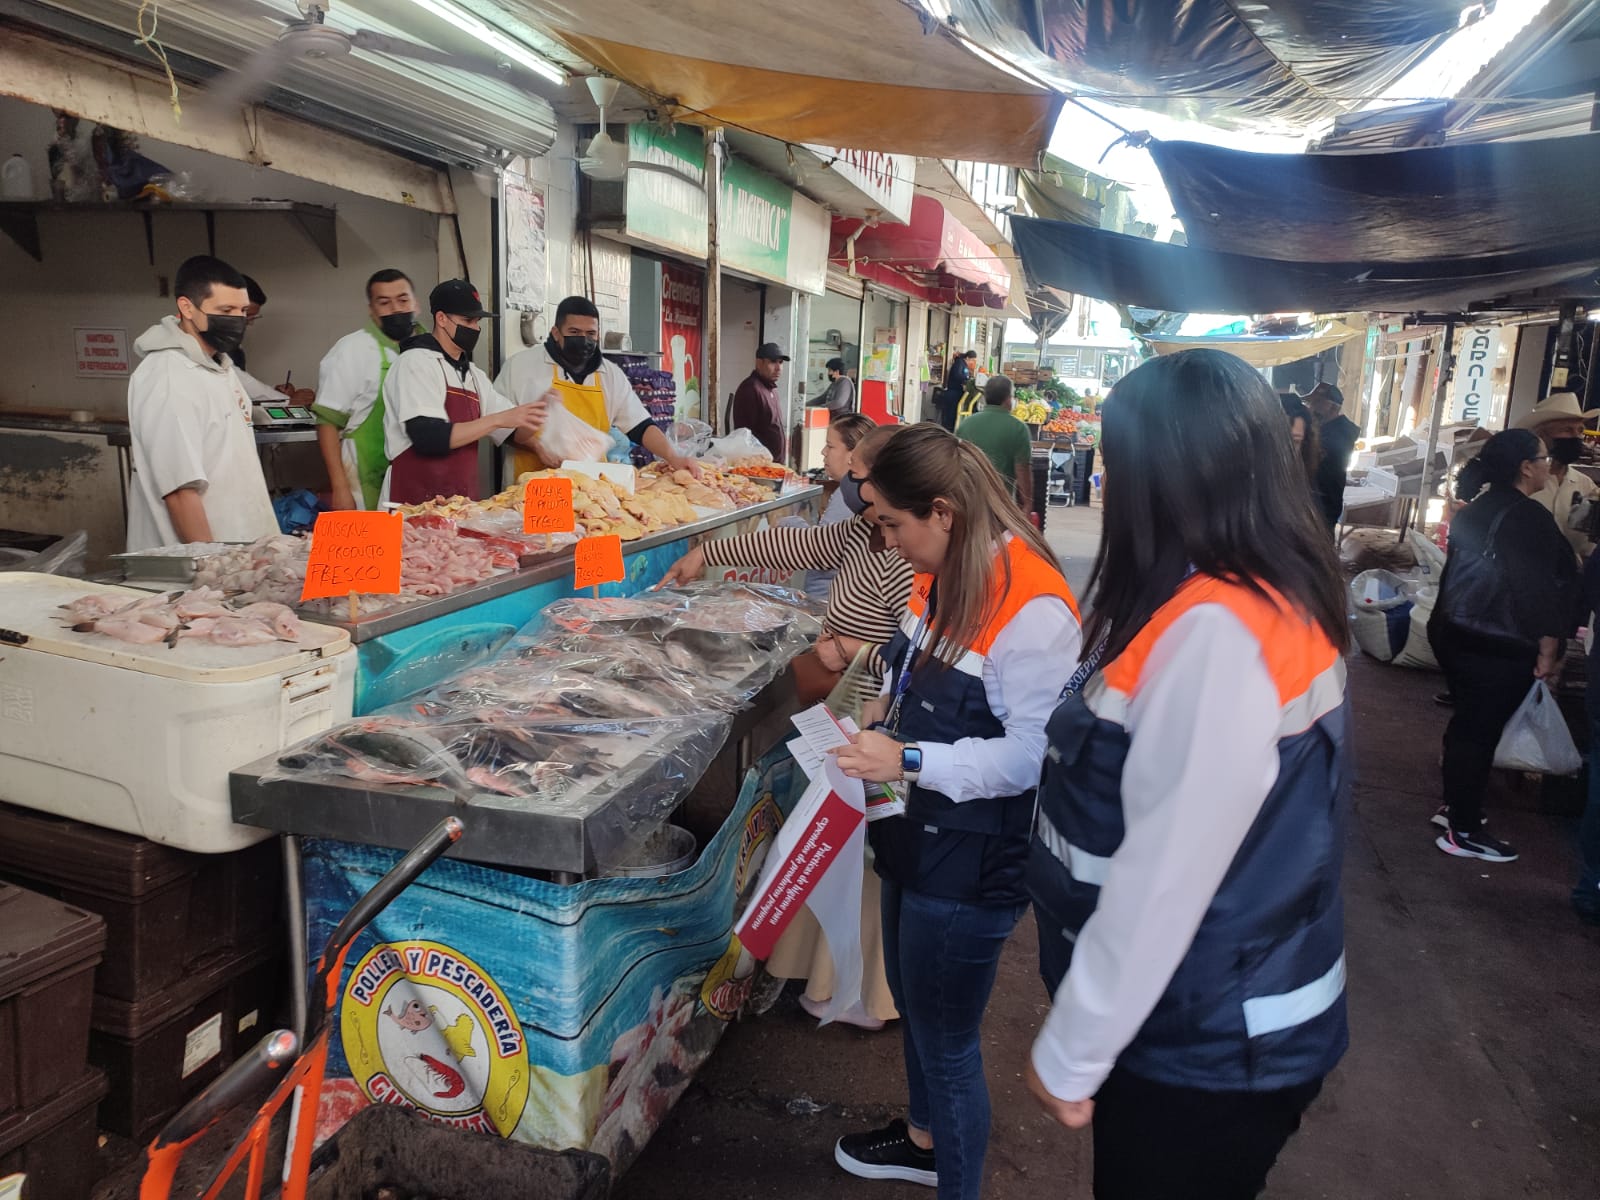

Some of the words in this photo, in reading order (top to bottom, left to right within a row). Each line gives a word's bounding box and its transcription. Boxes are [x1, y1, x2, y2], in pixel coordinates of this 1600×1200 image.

[327, 543, 385, 561] PRODUCTO
[406, 951, 421, 973] Y
[428, 953, 518, 1055] PESCADERÍA
